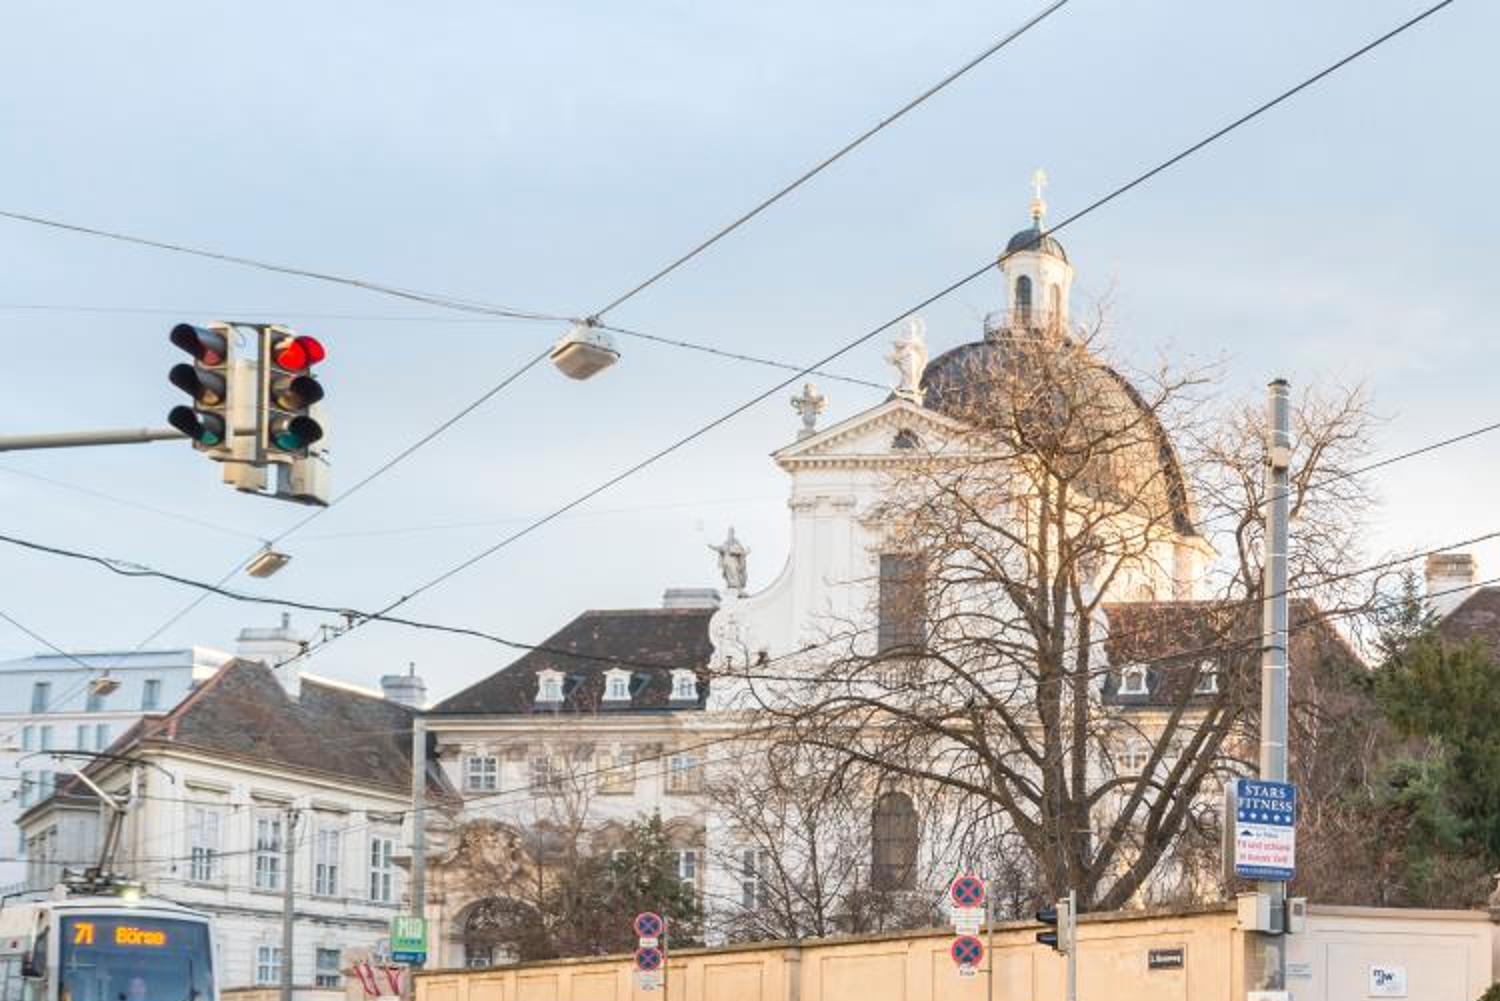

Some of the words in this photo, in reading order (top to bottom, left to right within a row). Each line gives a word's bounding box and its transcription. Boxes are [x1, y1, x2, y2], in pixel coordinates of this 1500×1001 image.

[1245, 785, 1286, 798] STARS
[1238, 798, 1293, 813] FITNESS
[73, 923, 94, 944] 71
[115, 927, 166, 945] Börse
